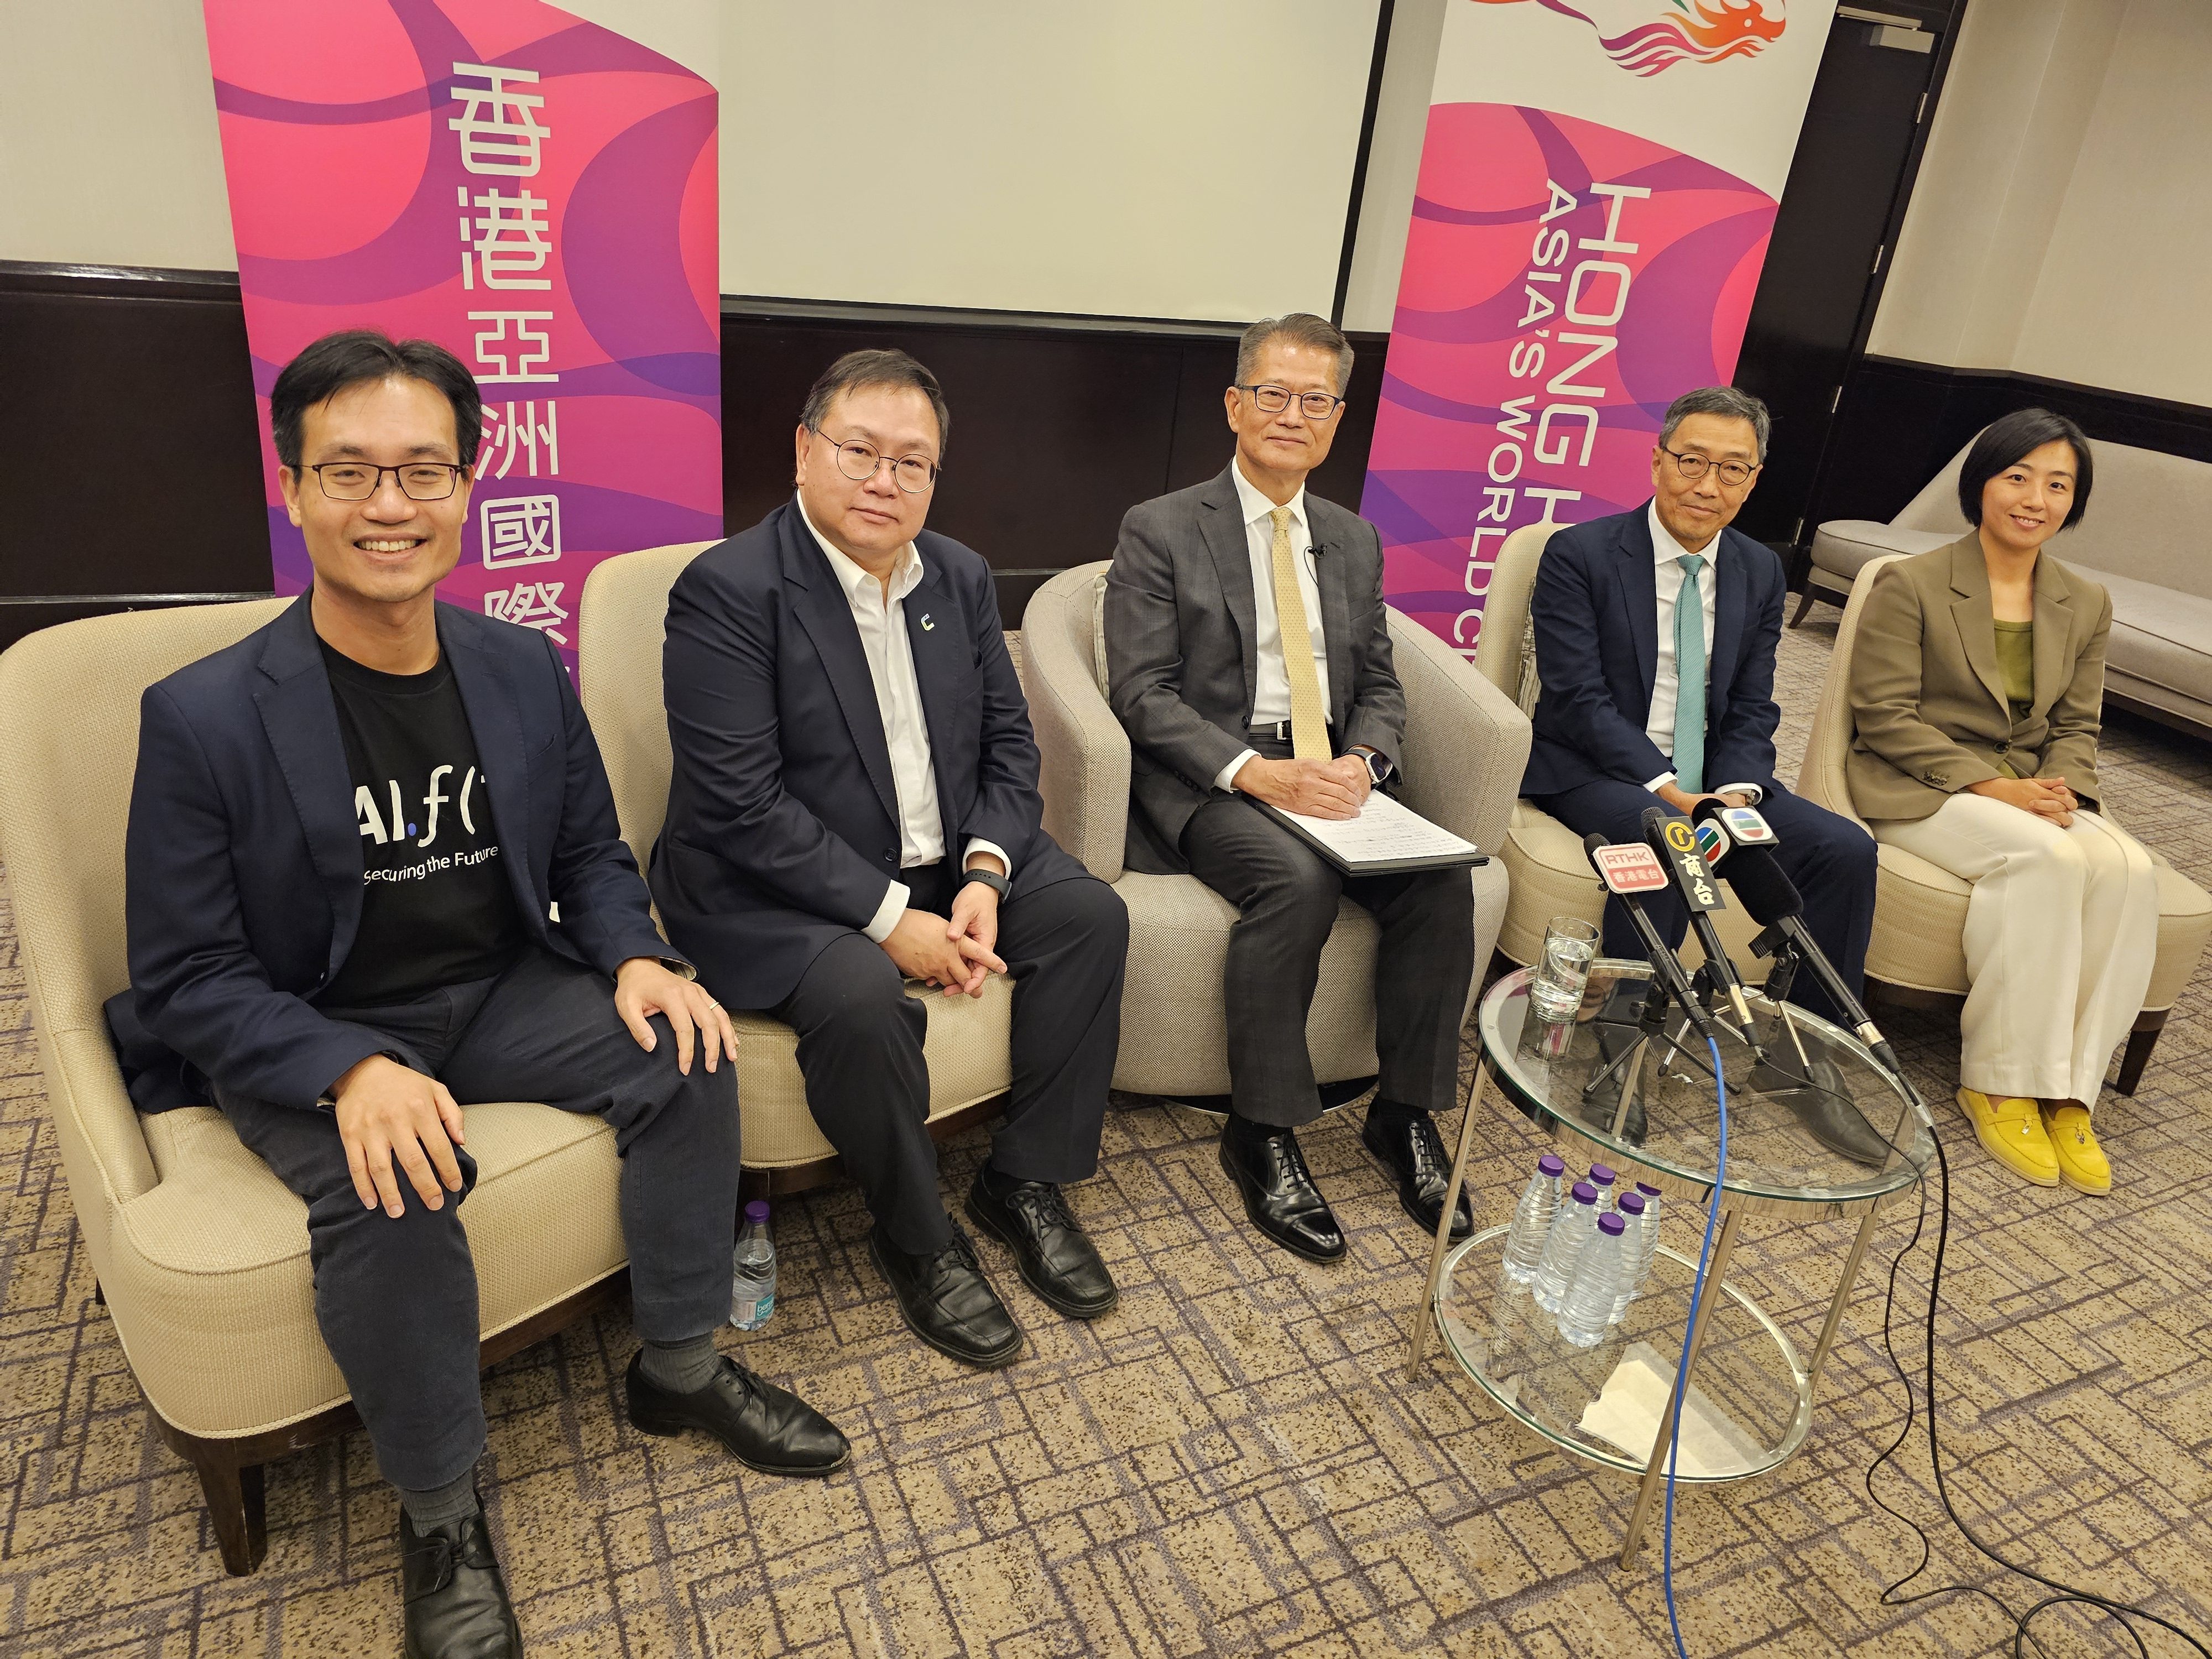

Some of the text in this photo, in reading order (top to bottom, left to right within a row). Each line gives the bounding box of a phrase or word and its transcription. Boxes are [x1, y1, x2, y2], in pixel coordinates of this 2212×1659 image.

[1533, 182, 1651, 466] HONG
[448, 62, 570, 673] 香港亞洲國際
[1452, 178, 1577, 664] ASIA'S WORLD CI
[426, 855, 450, 871] the
[455, 846, 498, 866] Future
[1604, 852, 1650, 864] RTHK
[1613, 869, 1660, 883] 香港電台
[1679, 853, 1714, 905] 商台
